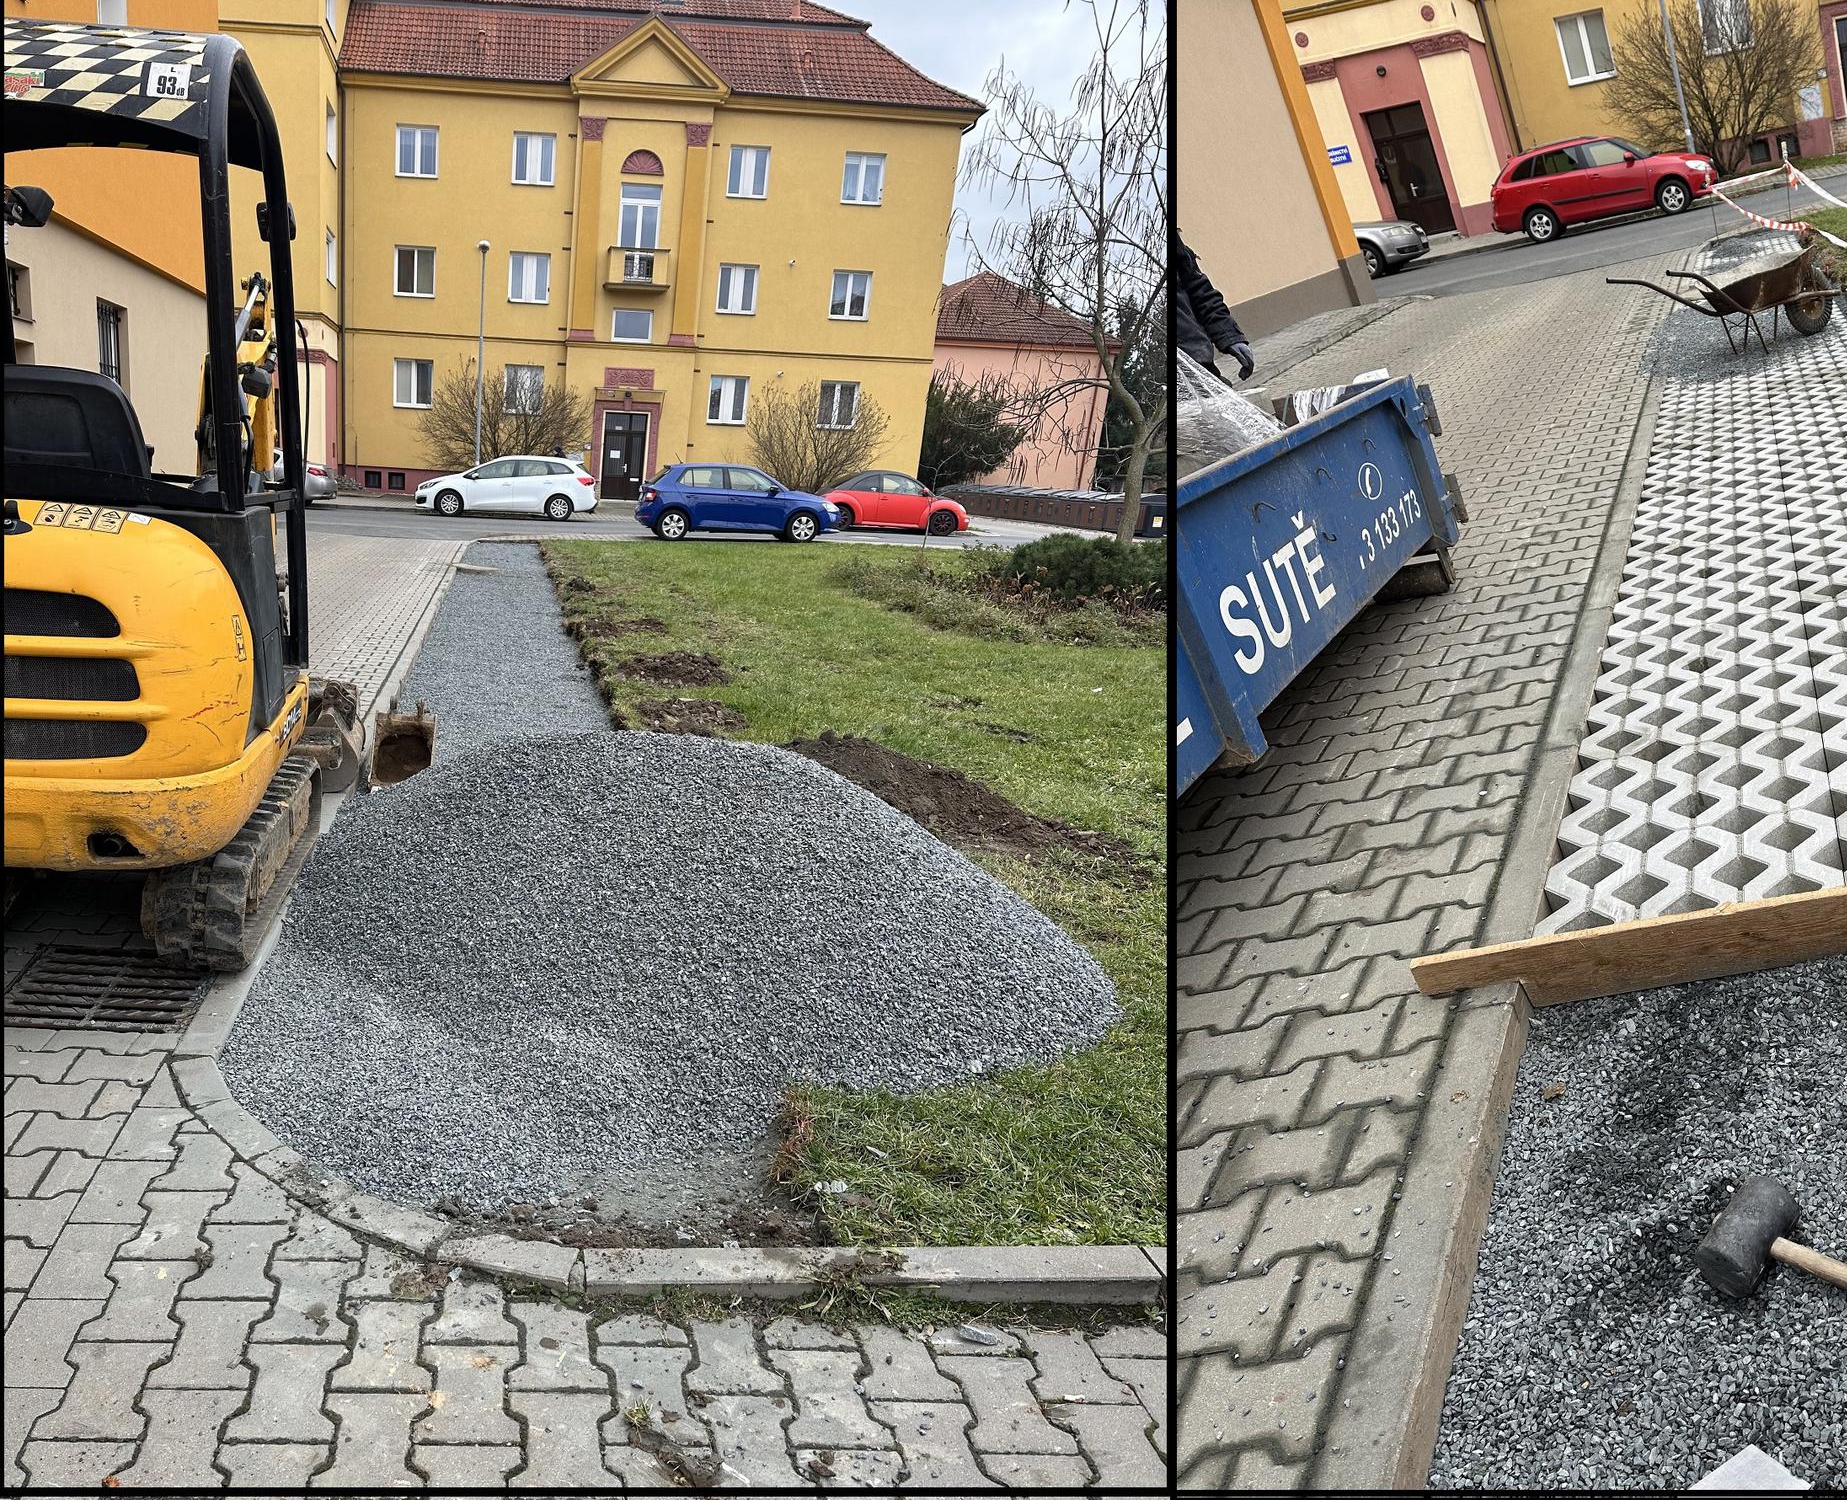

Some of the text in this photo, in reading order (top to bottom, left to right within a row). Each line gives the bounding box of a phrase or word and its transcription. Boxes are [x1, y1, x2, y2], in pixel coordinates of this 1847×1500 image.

[156, 75, 178, 96] 93
[1374, 506, 1400, 550] 133
[1399, 488, 1421, 529] 173
[1220, 510, 1337, 675] SUTĚ
